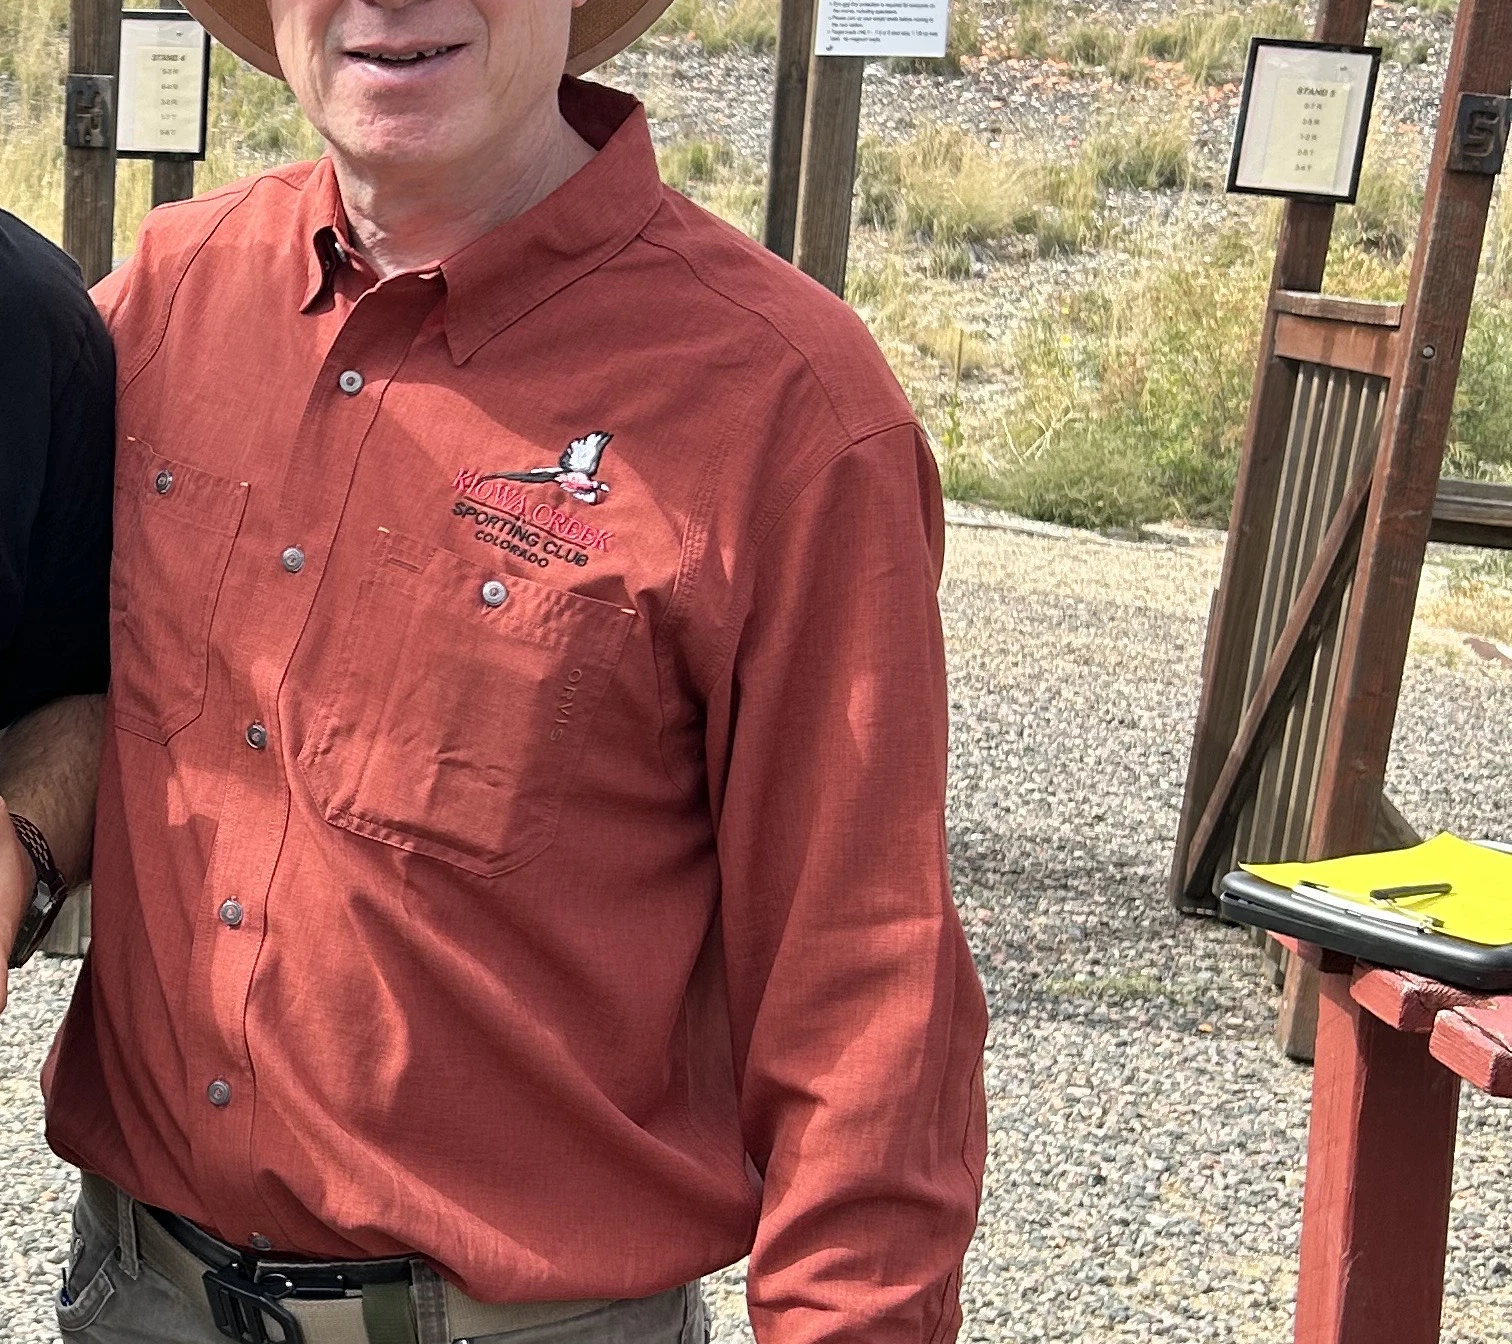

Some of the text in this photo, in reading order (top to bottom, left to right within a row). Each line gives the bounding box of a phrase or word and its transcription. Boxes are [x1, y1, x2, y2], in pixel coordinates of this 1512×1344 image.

[1296, 86, 1328, 97] STAND
[1463, 109, 1498, 156] 5
[451, 466, 615, 552] KIOWA CREEK
[452, 501, 590, 568] SPORTING CLUB
[474, 529, 549, 568] COLORADO
